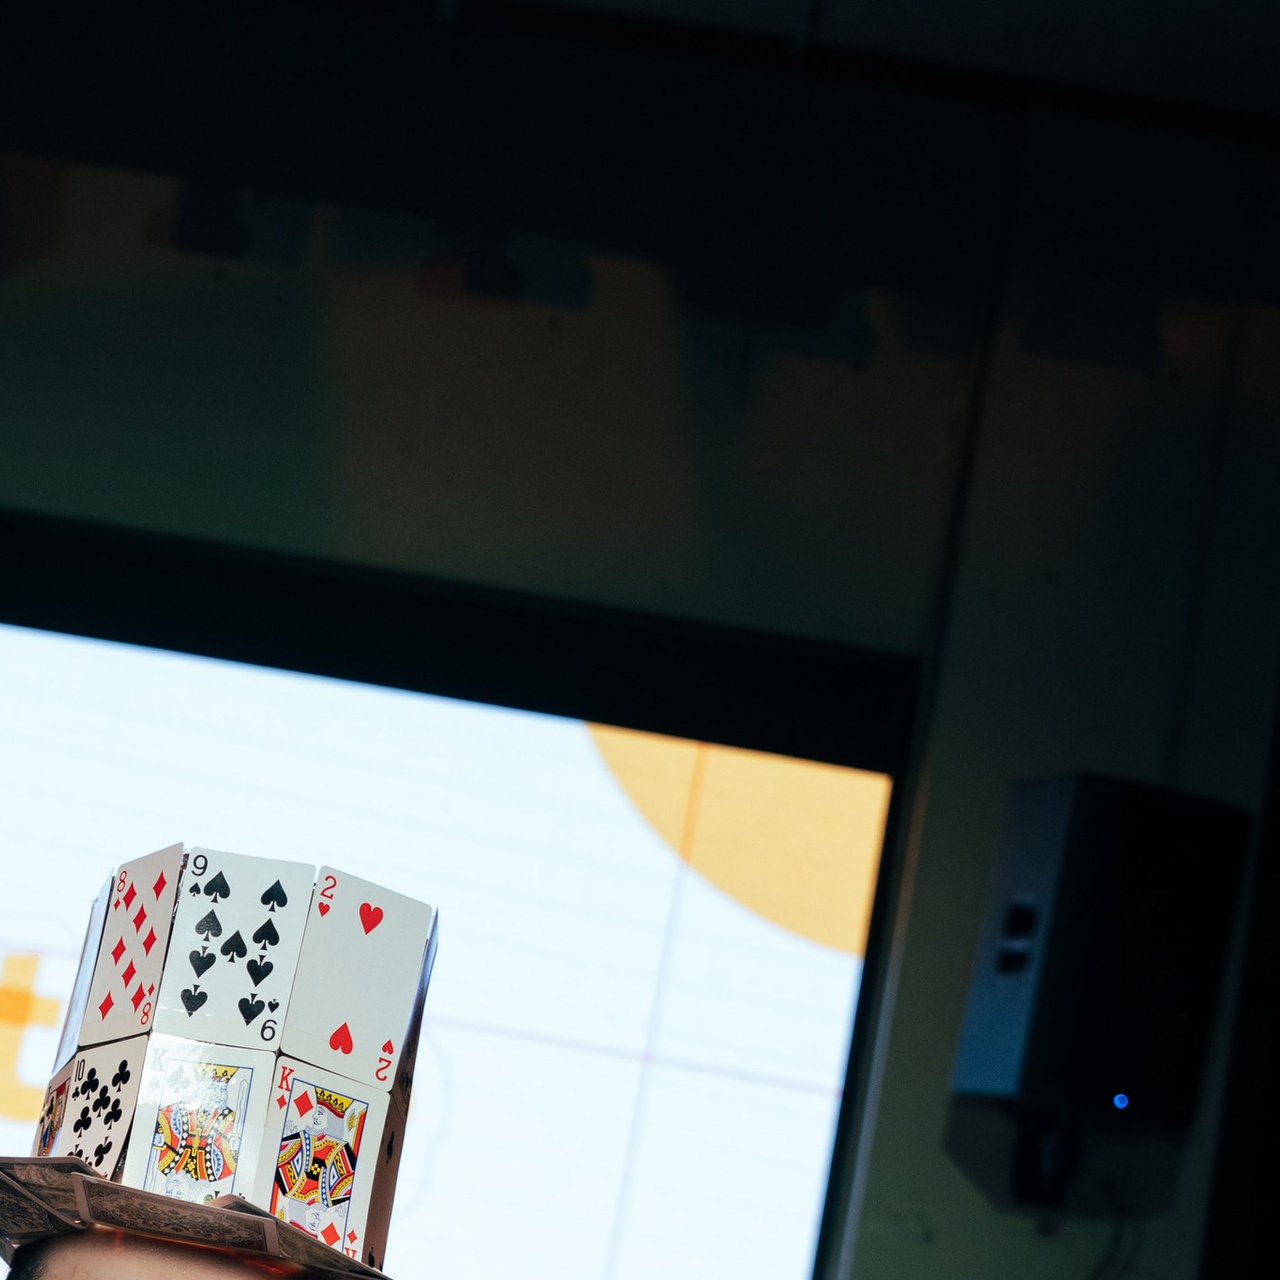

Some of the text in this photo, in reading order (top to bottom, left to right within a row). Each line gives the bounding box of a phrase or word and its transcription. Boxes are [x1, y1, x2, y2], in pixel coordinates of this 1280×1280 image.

[192, 855, 208, 876] 9
[117, 871, 127, 892] 8
[321, 876, 336, 899] 2
[141, 1002, 151, 1025] 8
[75, 1059, 85, 1082] 10
[278, 1066, 294, 1092] K
[376, 1057, 391, 1081] 2
